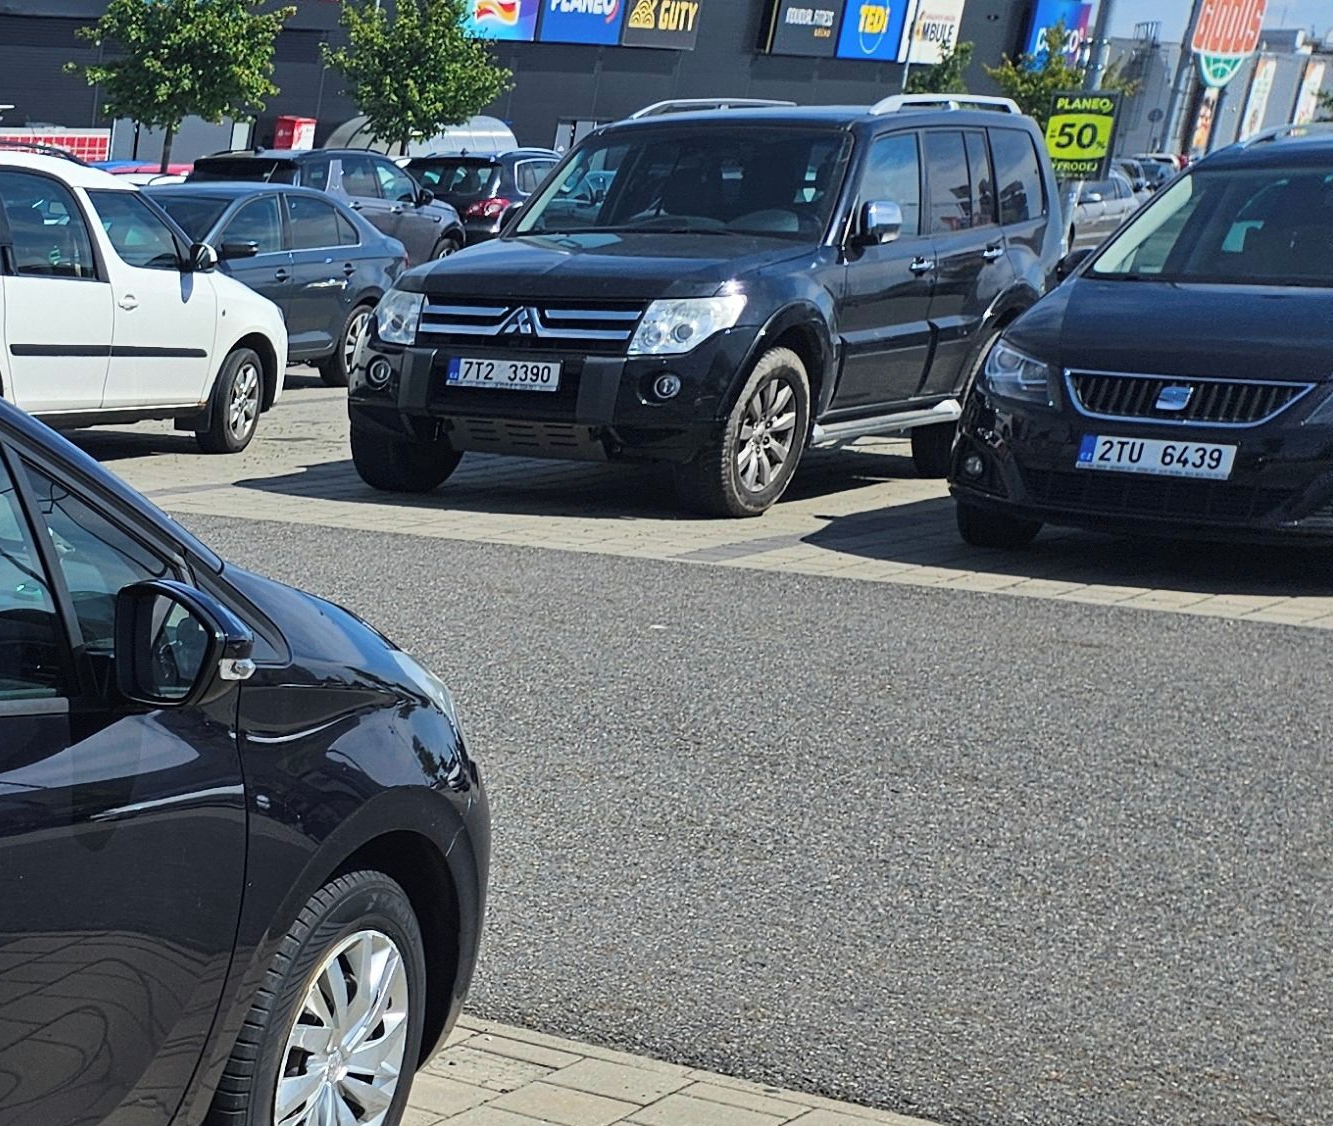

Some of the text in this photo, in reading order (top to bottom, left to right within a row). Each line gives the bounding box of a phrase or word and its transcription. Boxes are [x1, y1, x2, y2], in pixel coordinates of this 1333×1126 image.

[657, 1, 699, 31] GUTY
[463, 361, 495, 380] 7T2
[507, 363, 552, 384] 3390
[1098, 440, 1145, 464] 2TU
[1160, 445, 1223, 470] 6439
